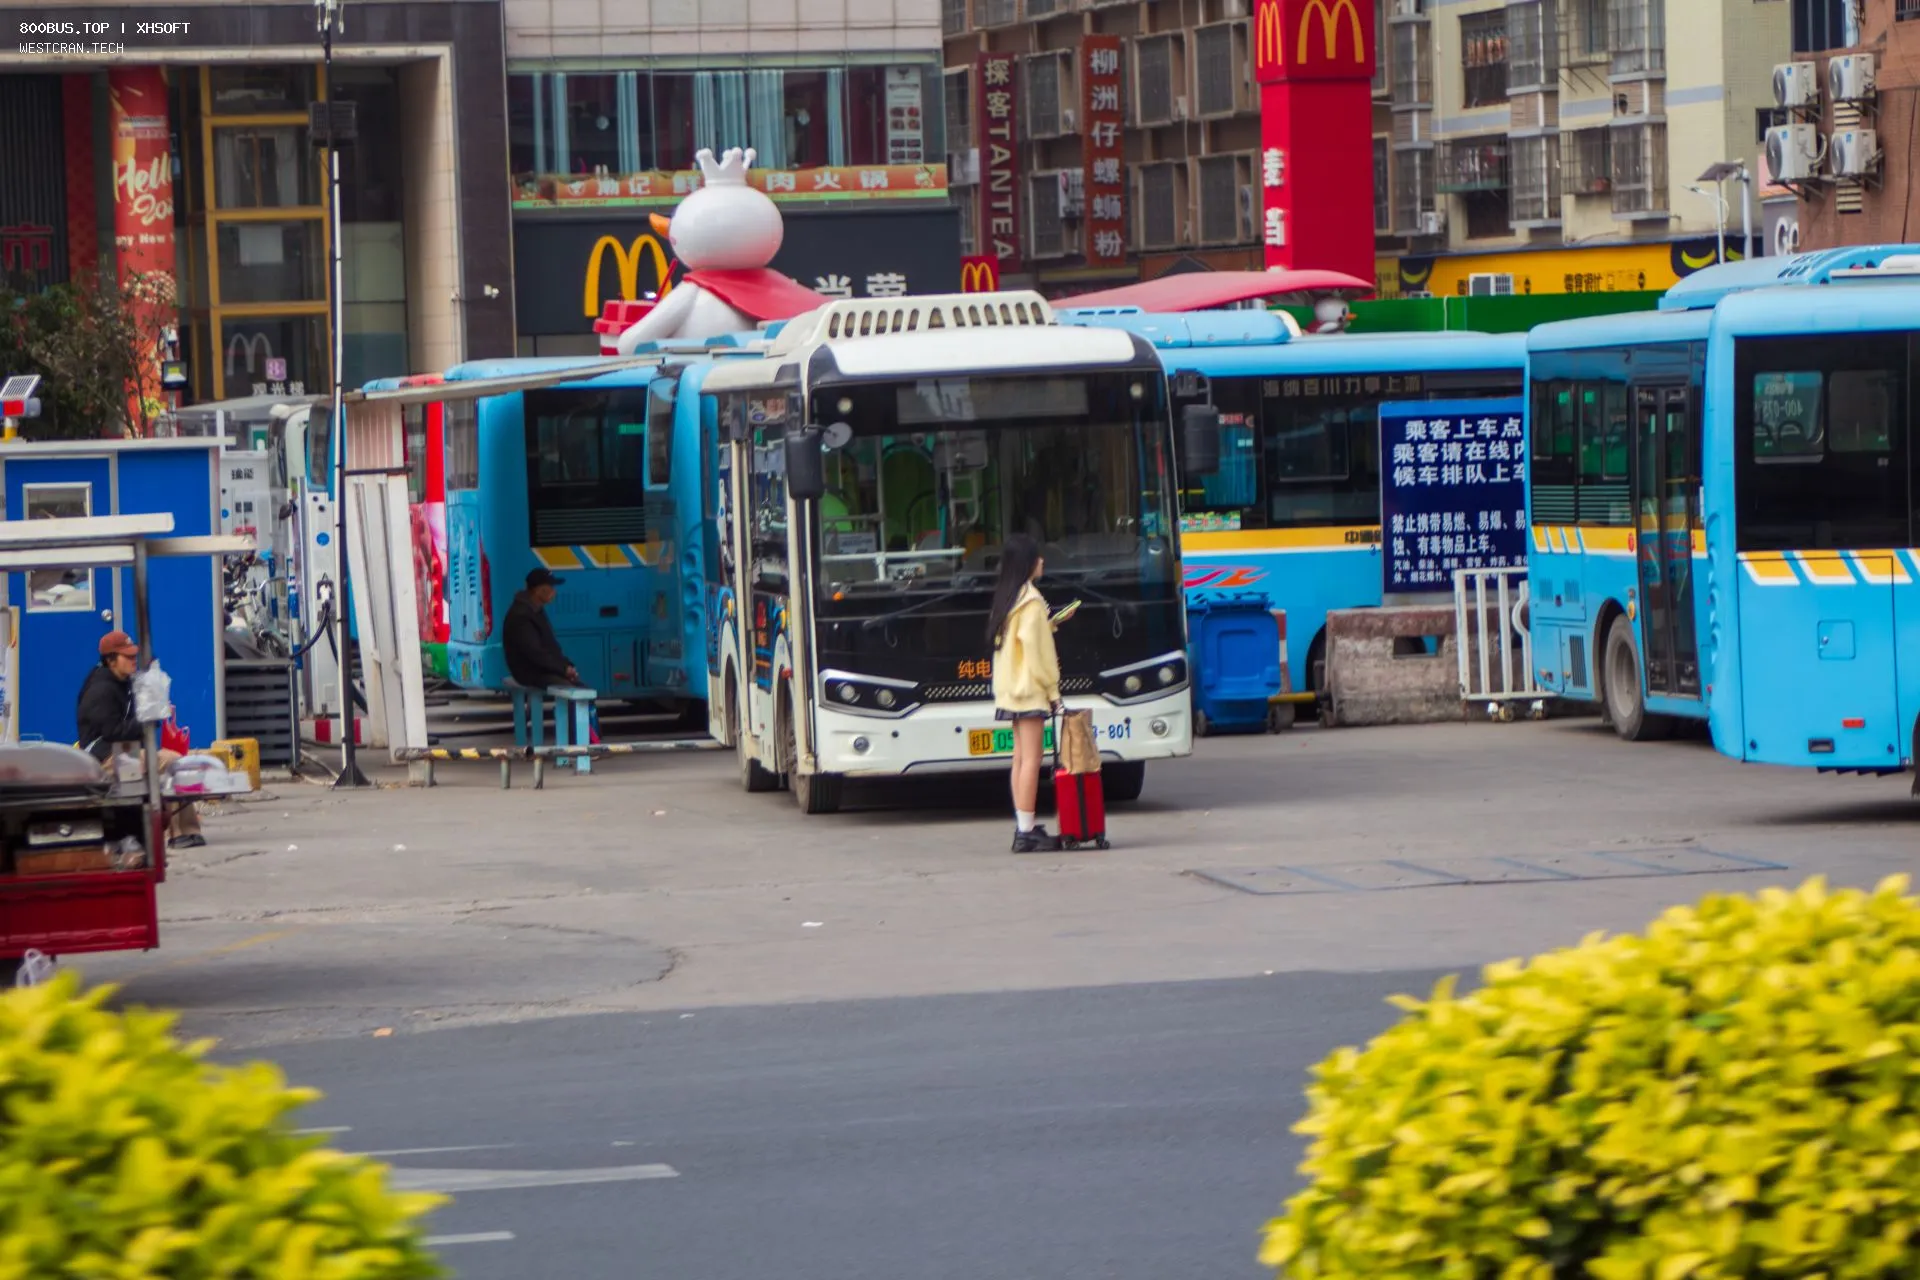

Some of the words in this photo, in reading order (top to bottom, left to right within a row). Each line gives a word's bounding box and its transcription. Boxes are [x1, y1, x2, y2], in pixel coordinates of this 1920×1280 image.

[1405, 416, 1523, 441] 乘客上车点
